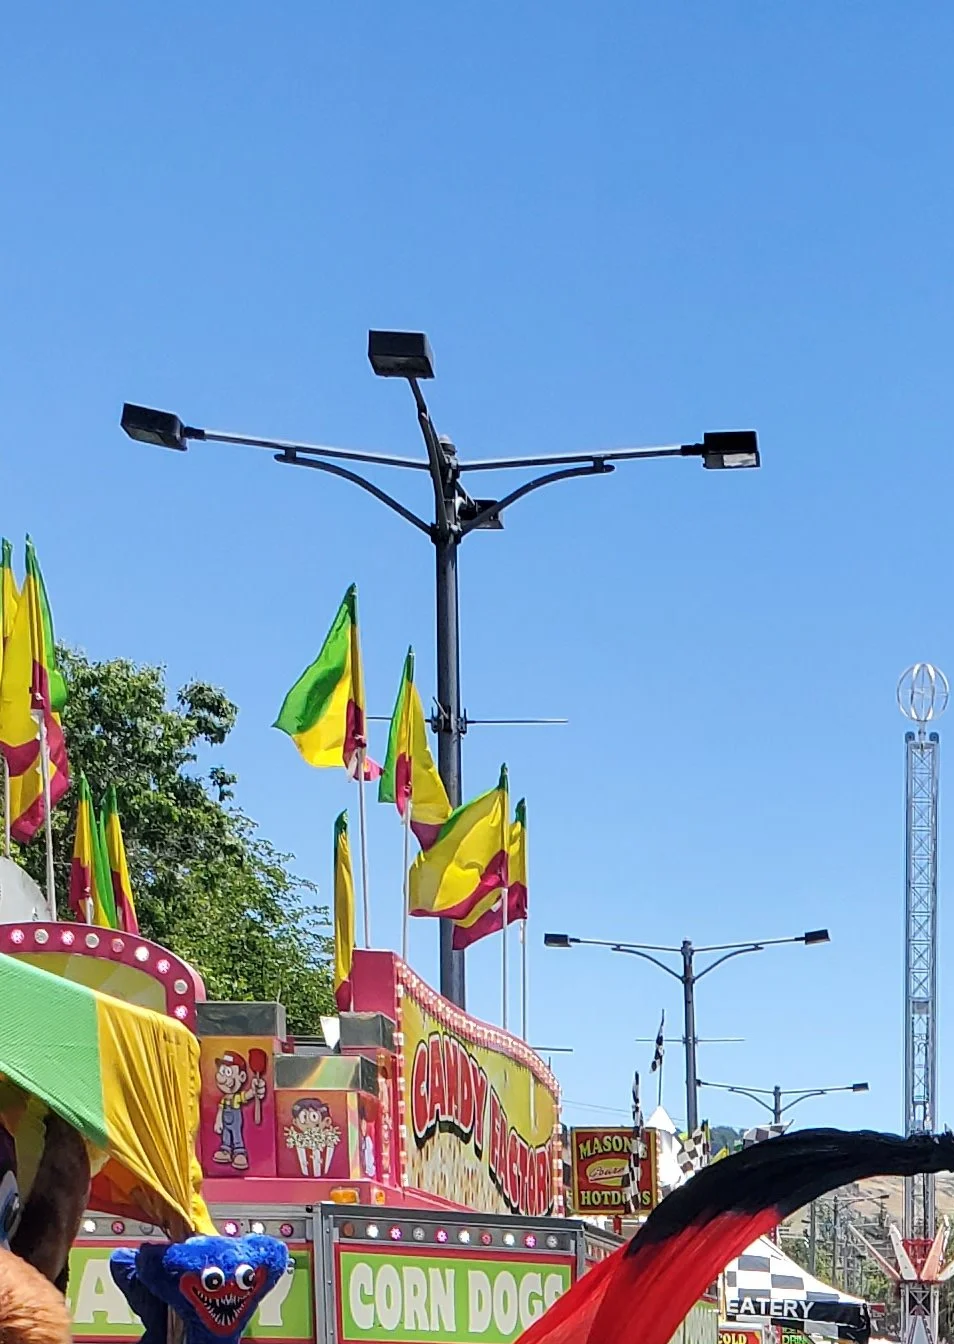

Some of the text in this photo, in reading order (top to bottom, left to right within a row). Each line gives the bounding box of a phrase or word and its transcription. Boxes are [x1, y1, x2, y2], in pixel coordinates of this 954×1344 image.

[412, 1032, 487, 1160] CANDY
[579, 1135, 648, 1159] MASONS
[580, 1190, 651, 1205] HOTDS
[350, 1262, 456, 1332] CORN
[727, 1297, 815, 1318] EATERY
